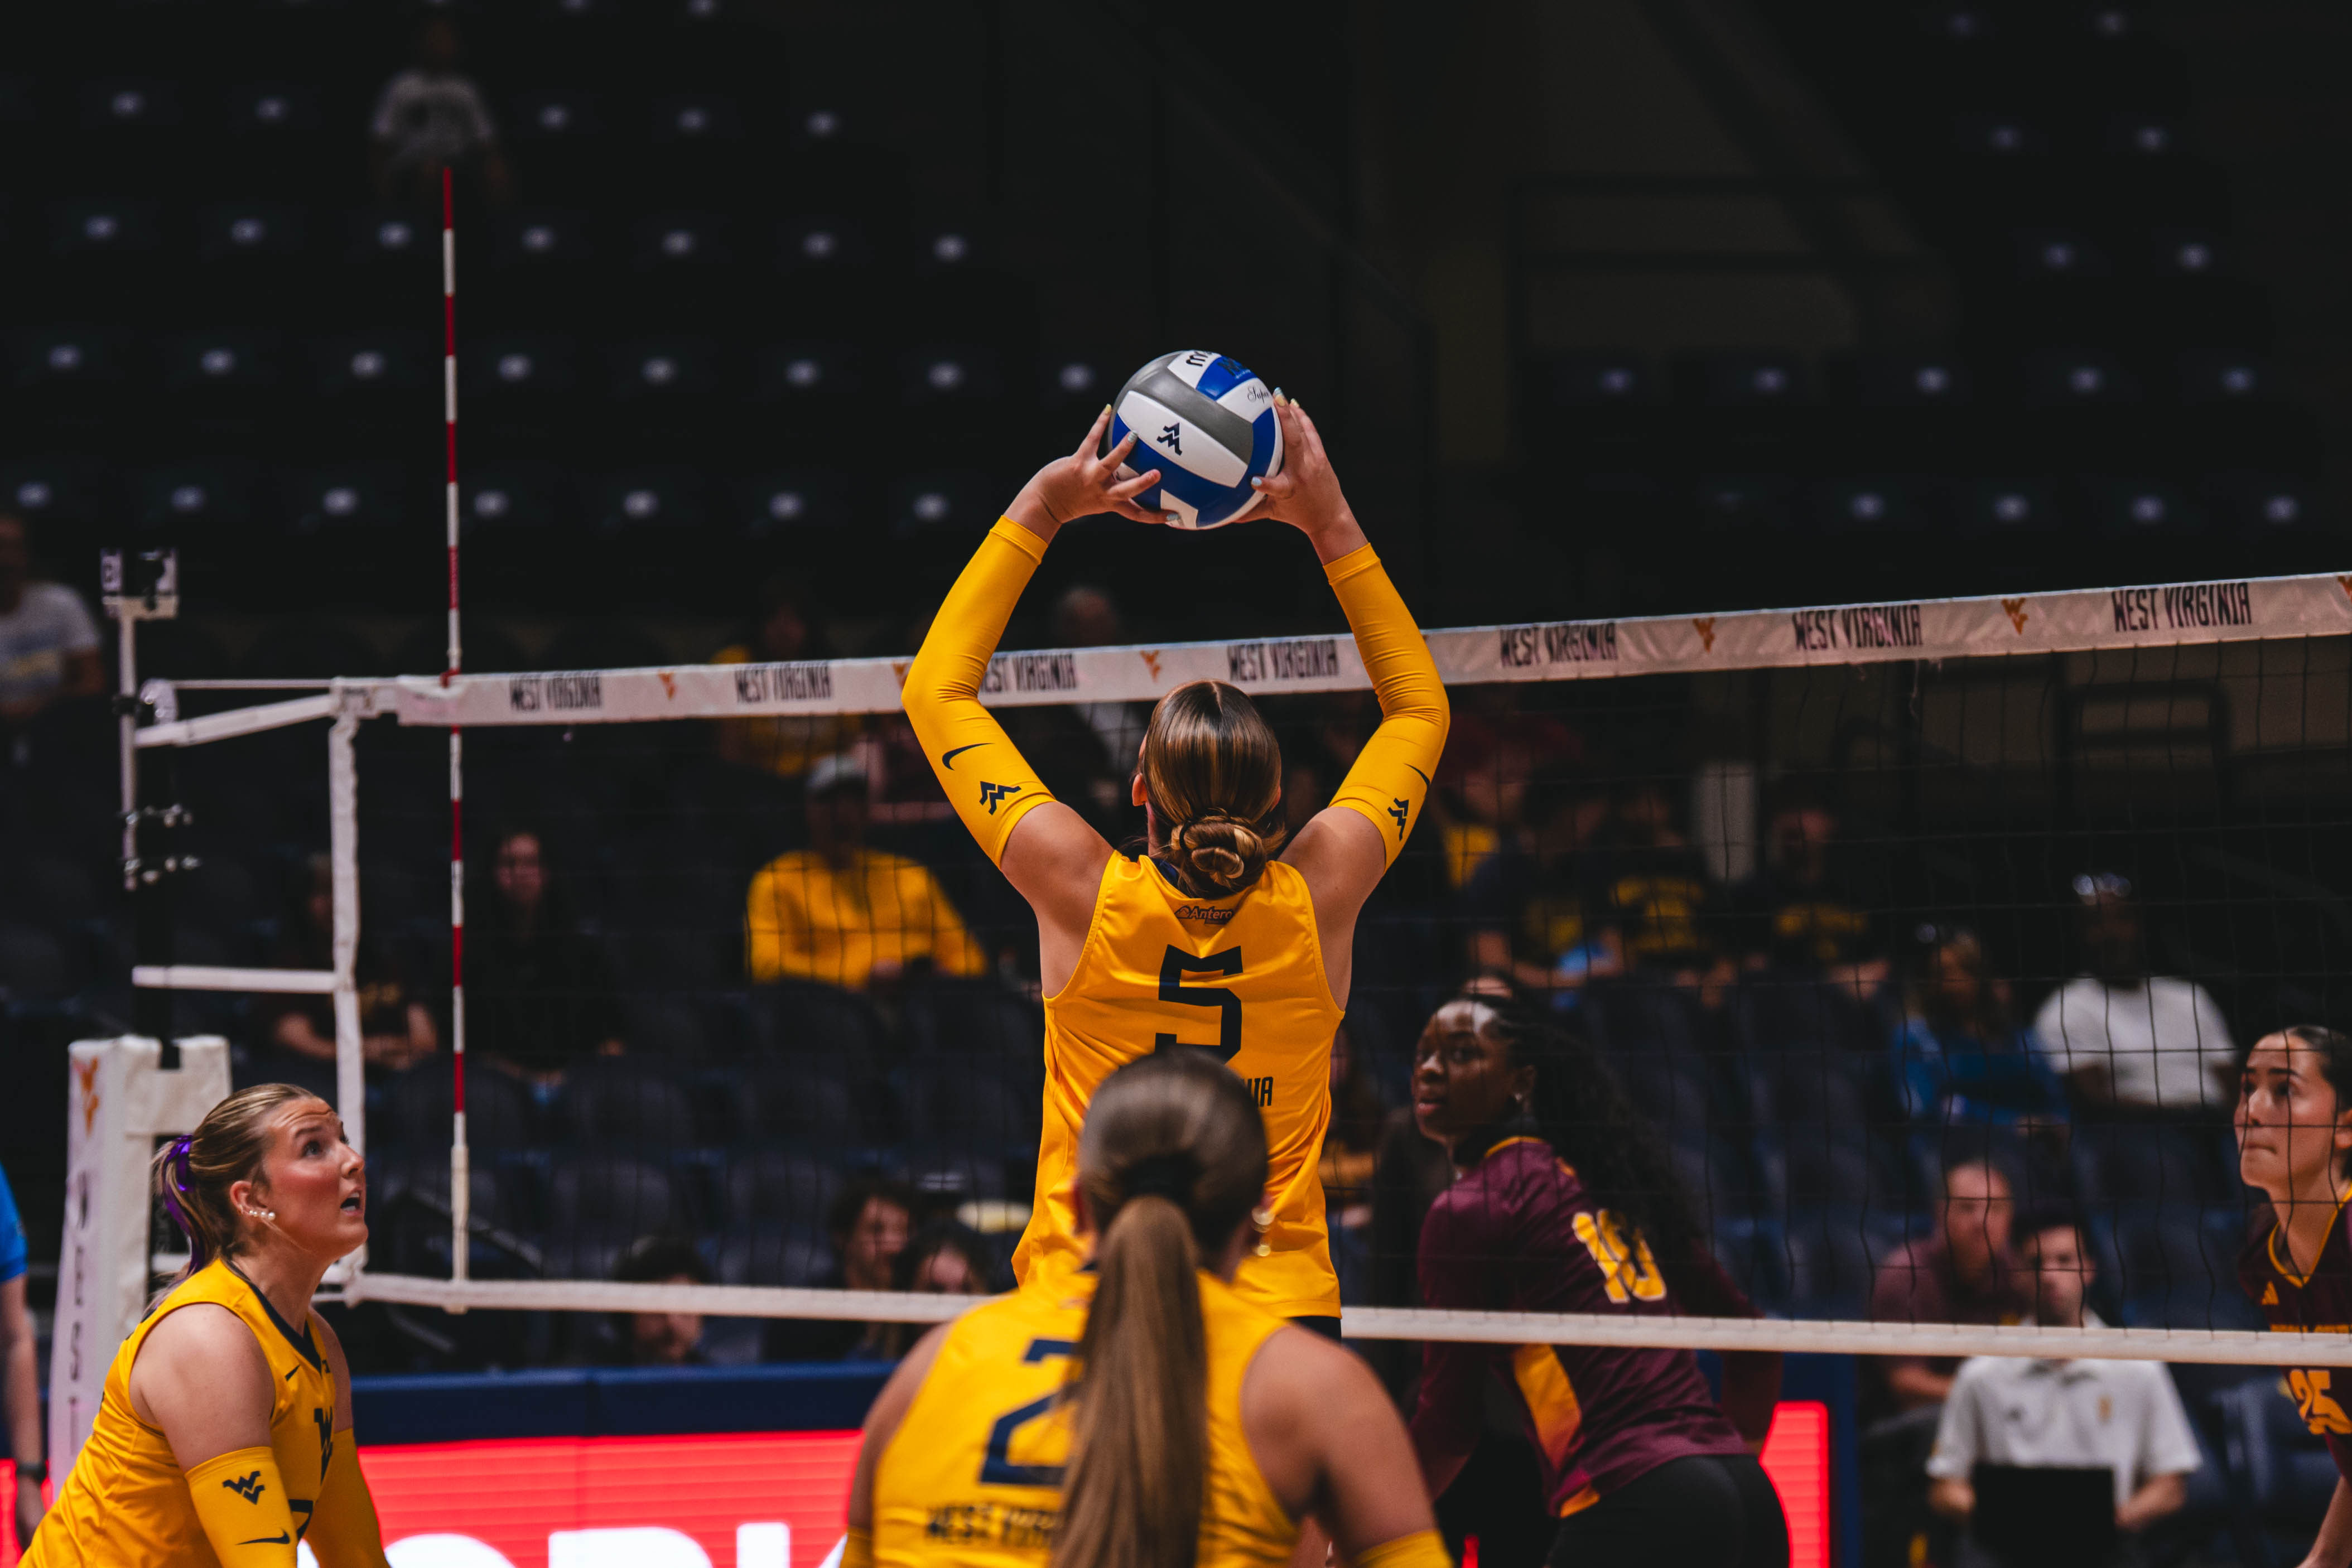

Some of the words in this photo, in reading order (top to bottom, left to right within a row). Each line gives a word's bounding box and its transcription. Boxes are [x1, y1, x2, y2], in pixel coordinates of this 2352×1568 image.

[1792, 610, 1837, 650] WEST
[1842, 604, 1922, 648] VIRGINIA
[2112, 588, 2158, 632] WEST
[2164, 582, 2252, 628] VIRGINIA
[1227, 643, 1267, 681] WEST
[1269, 639, 1338, 678] VIRGINIA
[1501, 626, 1541, 667] WEST
[1544, 623, 1618, 662] VIRGINIA
[1012, 653, 1077, 691] VIRGINIA
[1188, 905, 1233, 919] Antero
[1155, 944, 1244, 1063] 5
[980, 1339, 1078, 1485] 2
